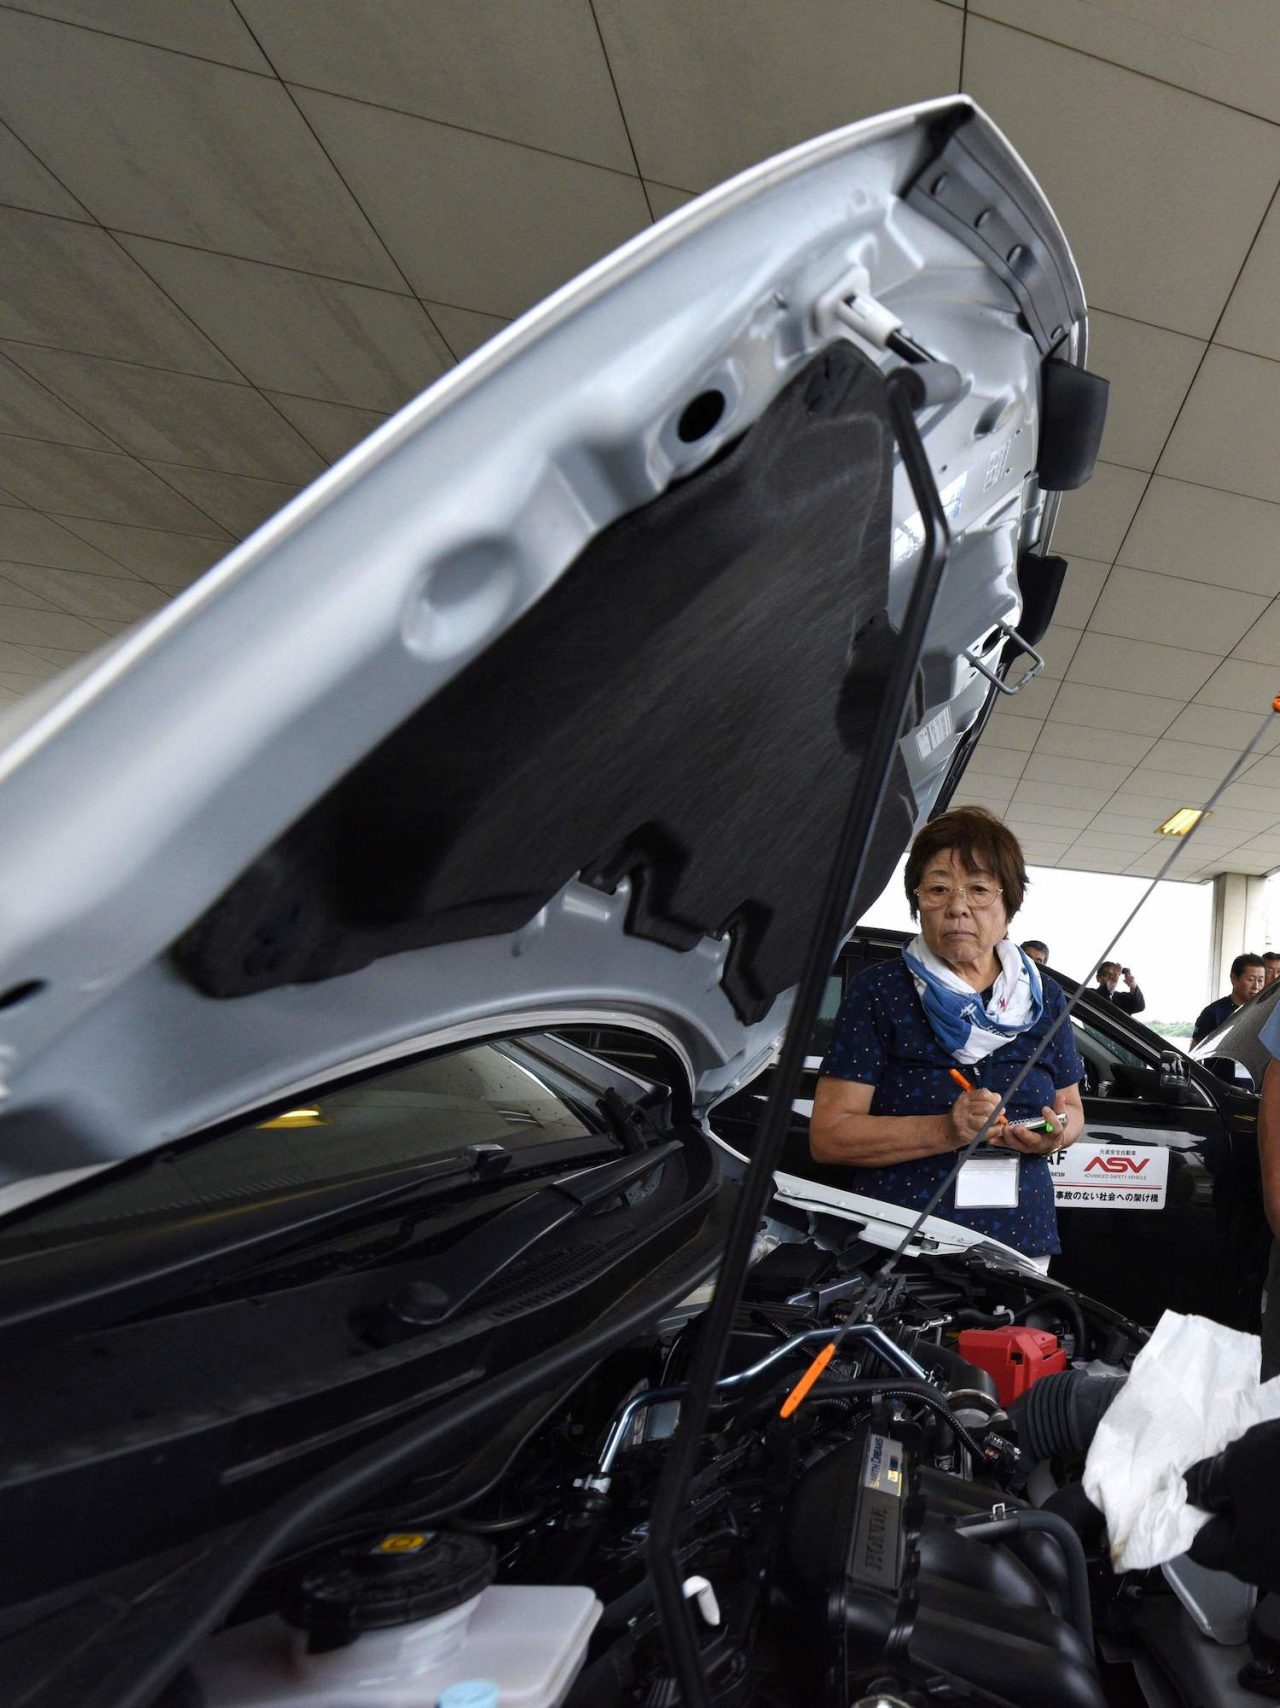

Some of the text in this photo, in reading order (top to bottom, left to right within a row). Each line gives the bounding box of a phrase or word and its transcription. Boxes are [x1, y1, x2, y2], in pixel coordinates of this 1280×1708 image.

[1047, 1150, 1067, 1165] AF
[1083, 1156, 1150, 1173] ASV
[1056, 1190, 1159, 1203] 事故のない社会への架け橋
